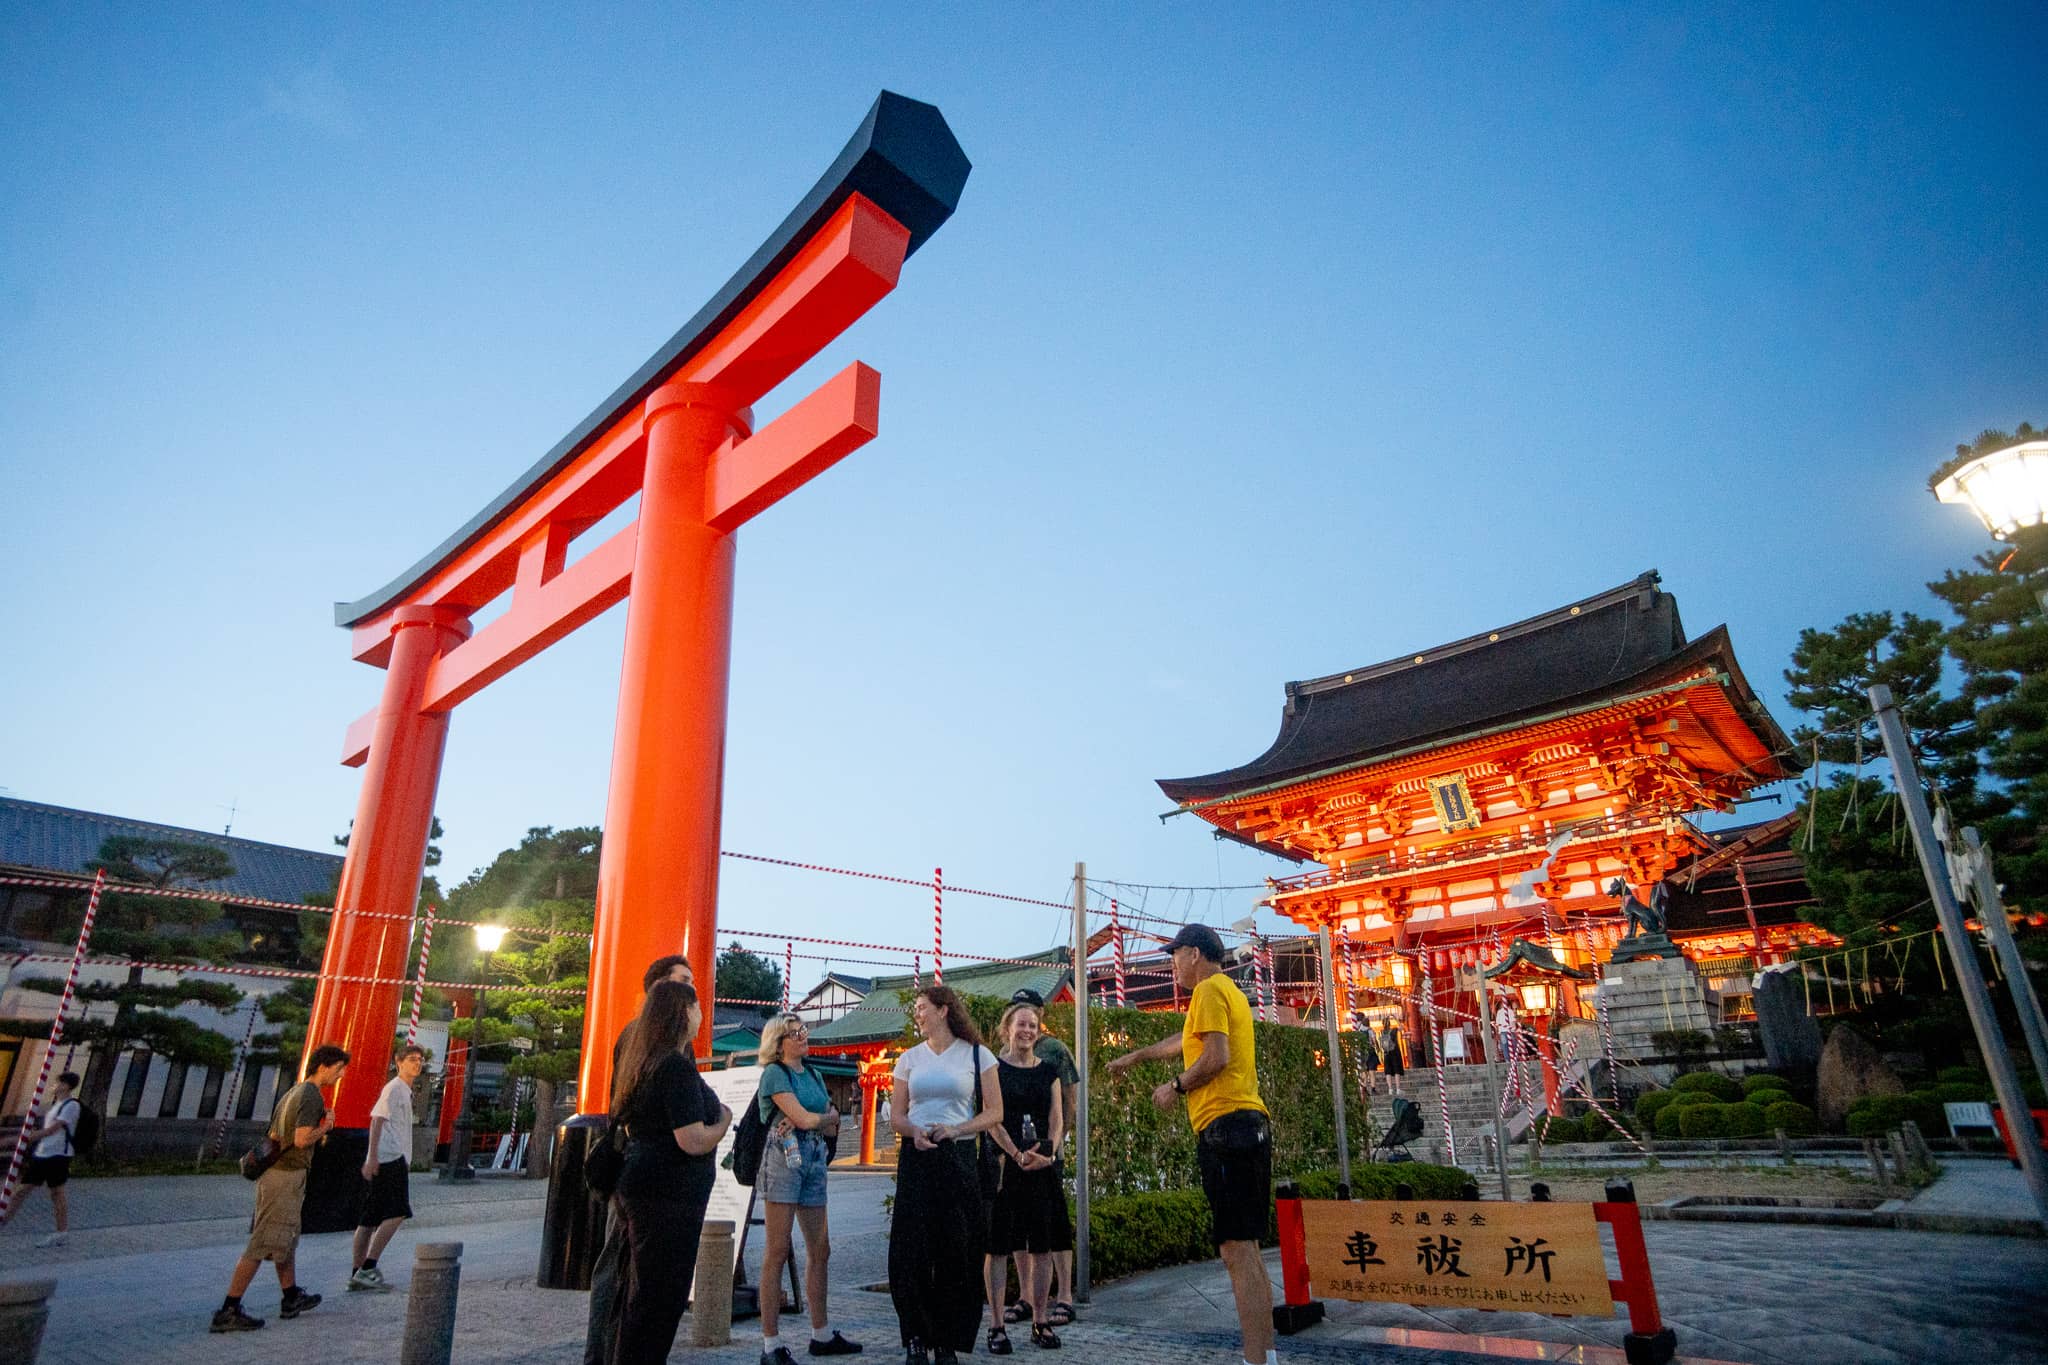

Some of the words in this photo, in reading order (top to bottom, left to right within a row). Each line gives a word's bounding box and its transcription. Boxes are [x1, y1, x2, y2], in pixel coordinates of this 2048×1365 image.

[1390, 1211, 1487, 1226] 交通安全
[1342, 1231, 1556, 1282] 車祓所
